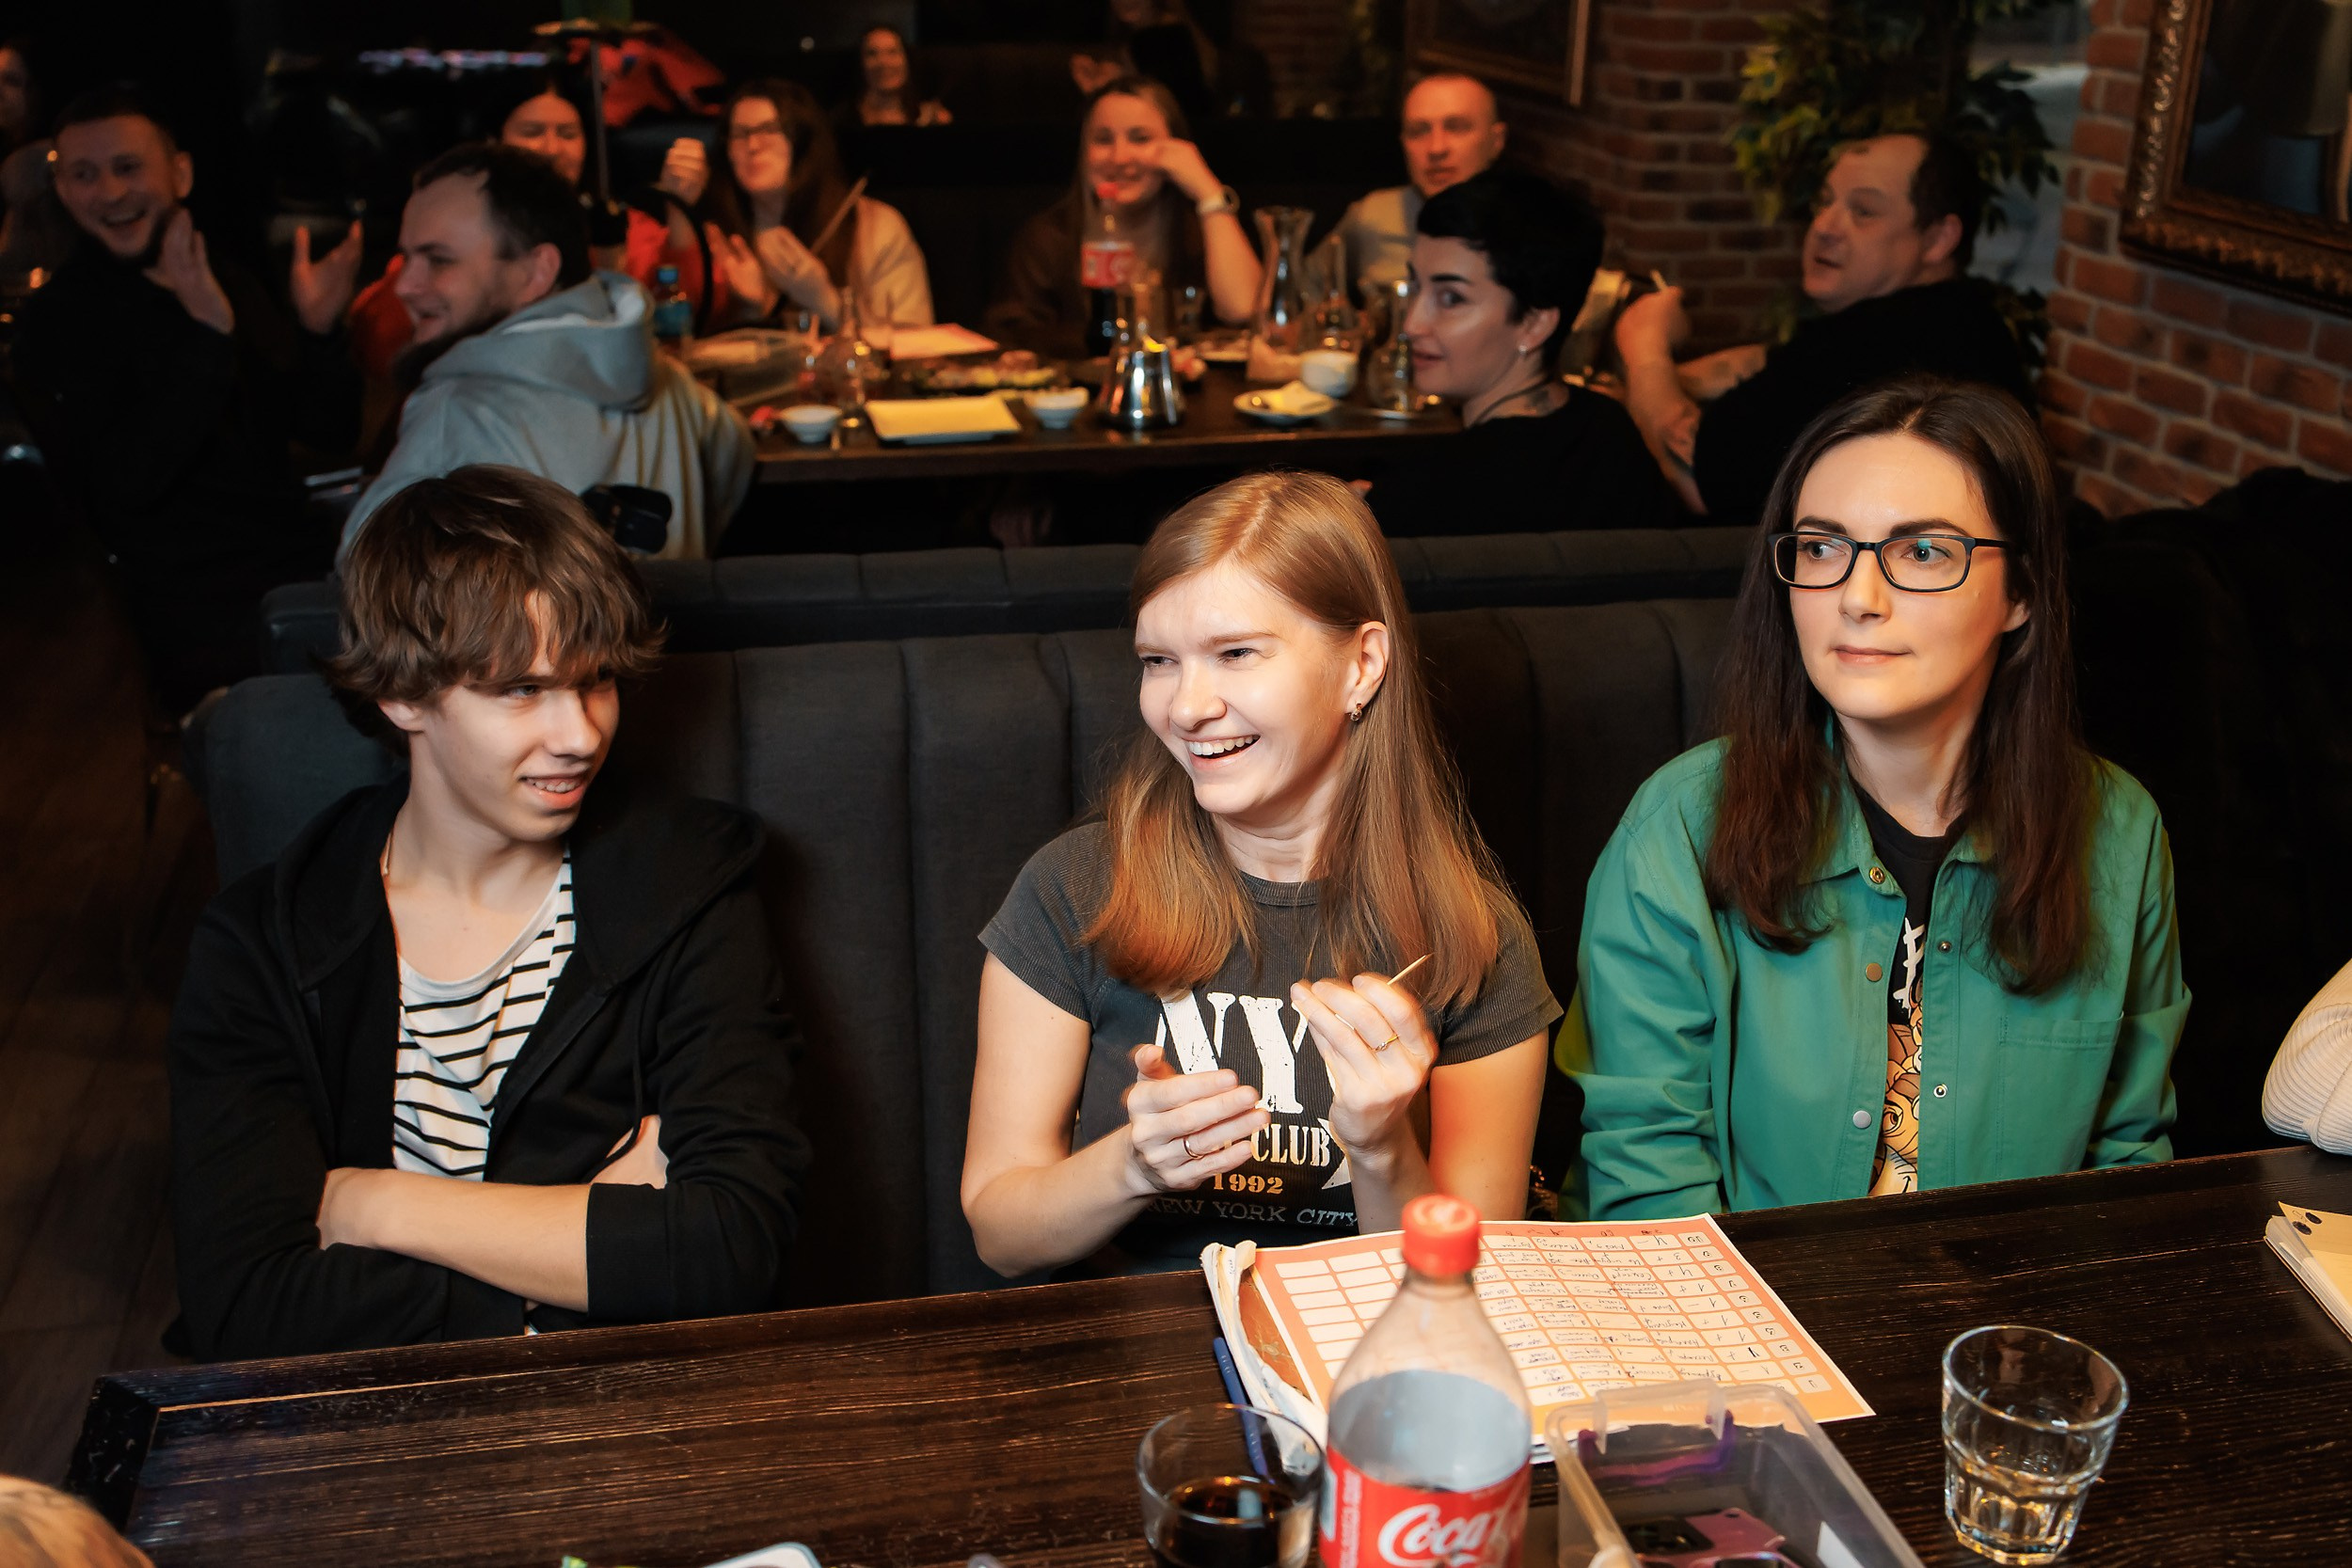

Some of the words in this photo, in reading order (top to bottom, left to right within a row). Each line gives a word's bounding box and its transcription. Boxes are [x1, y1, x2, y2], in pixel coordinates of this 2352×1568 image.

[1250, 1122, 1331, 1167] CLUB
[1213, 1172, 1283, 1195] 1992
[1213, 1200, 1287, 1223] YORK
[1296, 1208, 1358, 1227] CITY
[1377, 1503, 1492, 1567] Coca
